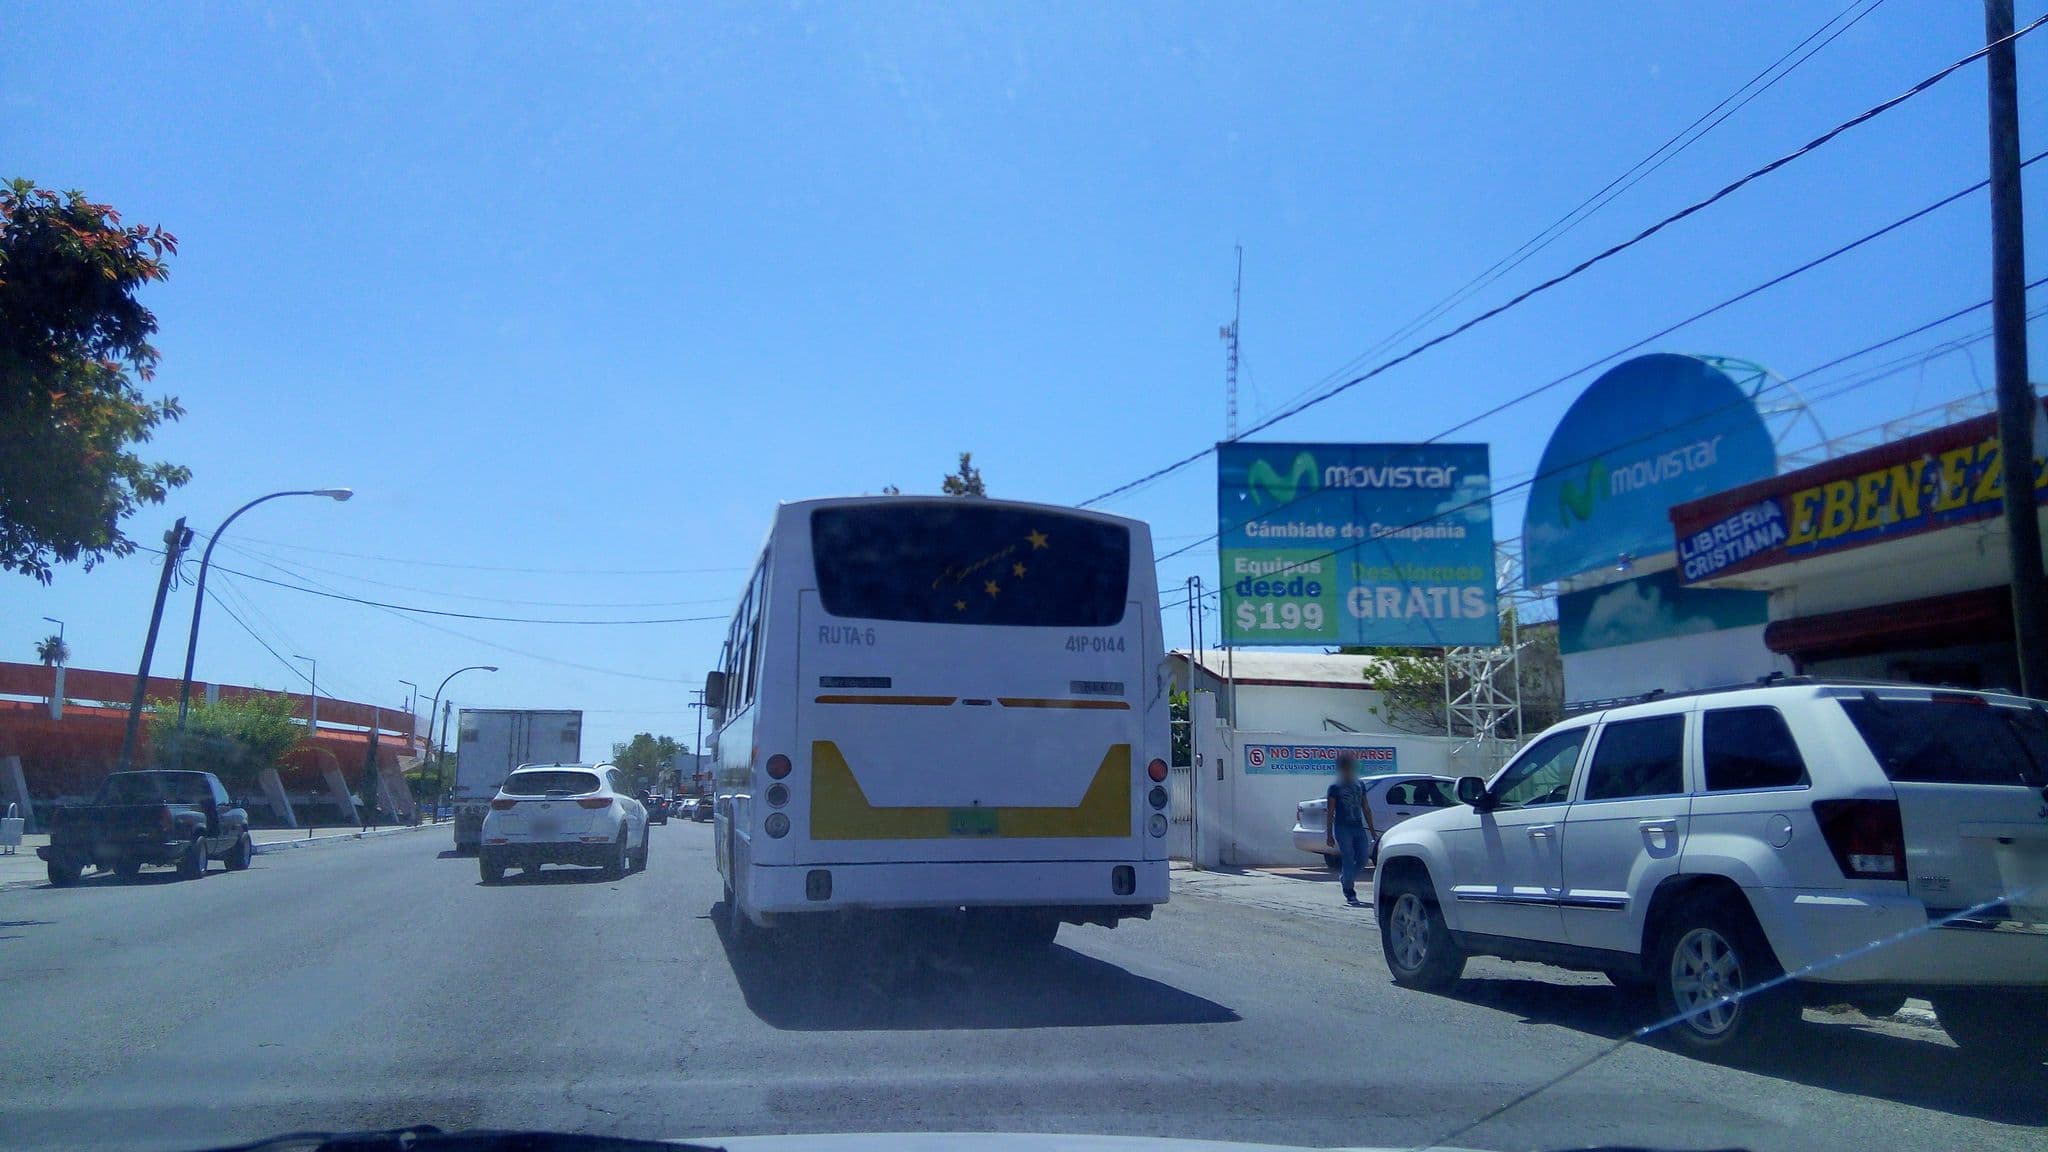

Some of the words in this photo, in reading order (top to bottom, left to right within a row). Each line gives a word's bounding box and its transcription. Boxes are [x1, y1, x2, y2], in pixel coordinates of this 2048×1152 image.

[1611, 434, 1723, 497] movistar
[1324, 466, 1457, 488] movistar
[1245, 520, 1336, 539] Cámbiate
[1680, 500, 1782, 560] LIBRERIA
[1684, 521, 1786, 580] CRISTIANA
[1235, 557, 1321, 576] Equipos
[1236, 575, 1322, 598] desde
[1347, 586, 1487, 619] GRATIS
[1236, 601, 1324, 631] $199
[1065, 635, 1126, 653] 41P-0144
[1270, 746, 1290, 760] NO
[1294, 747, 1393, 761] ESTACINARSE
[1271, 763, 1310, 771] EXCLUSIVO
